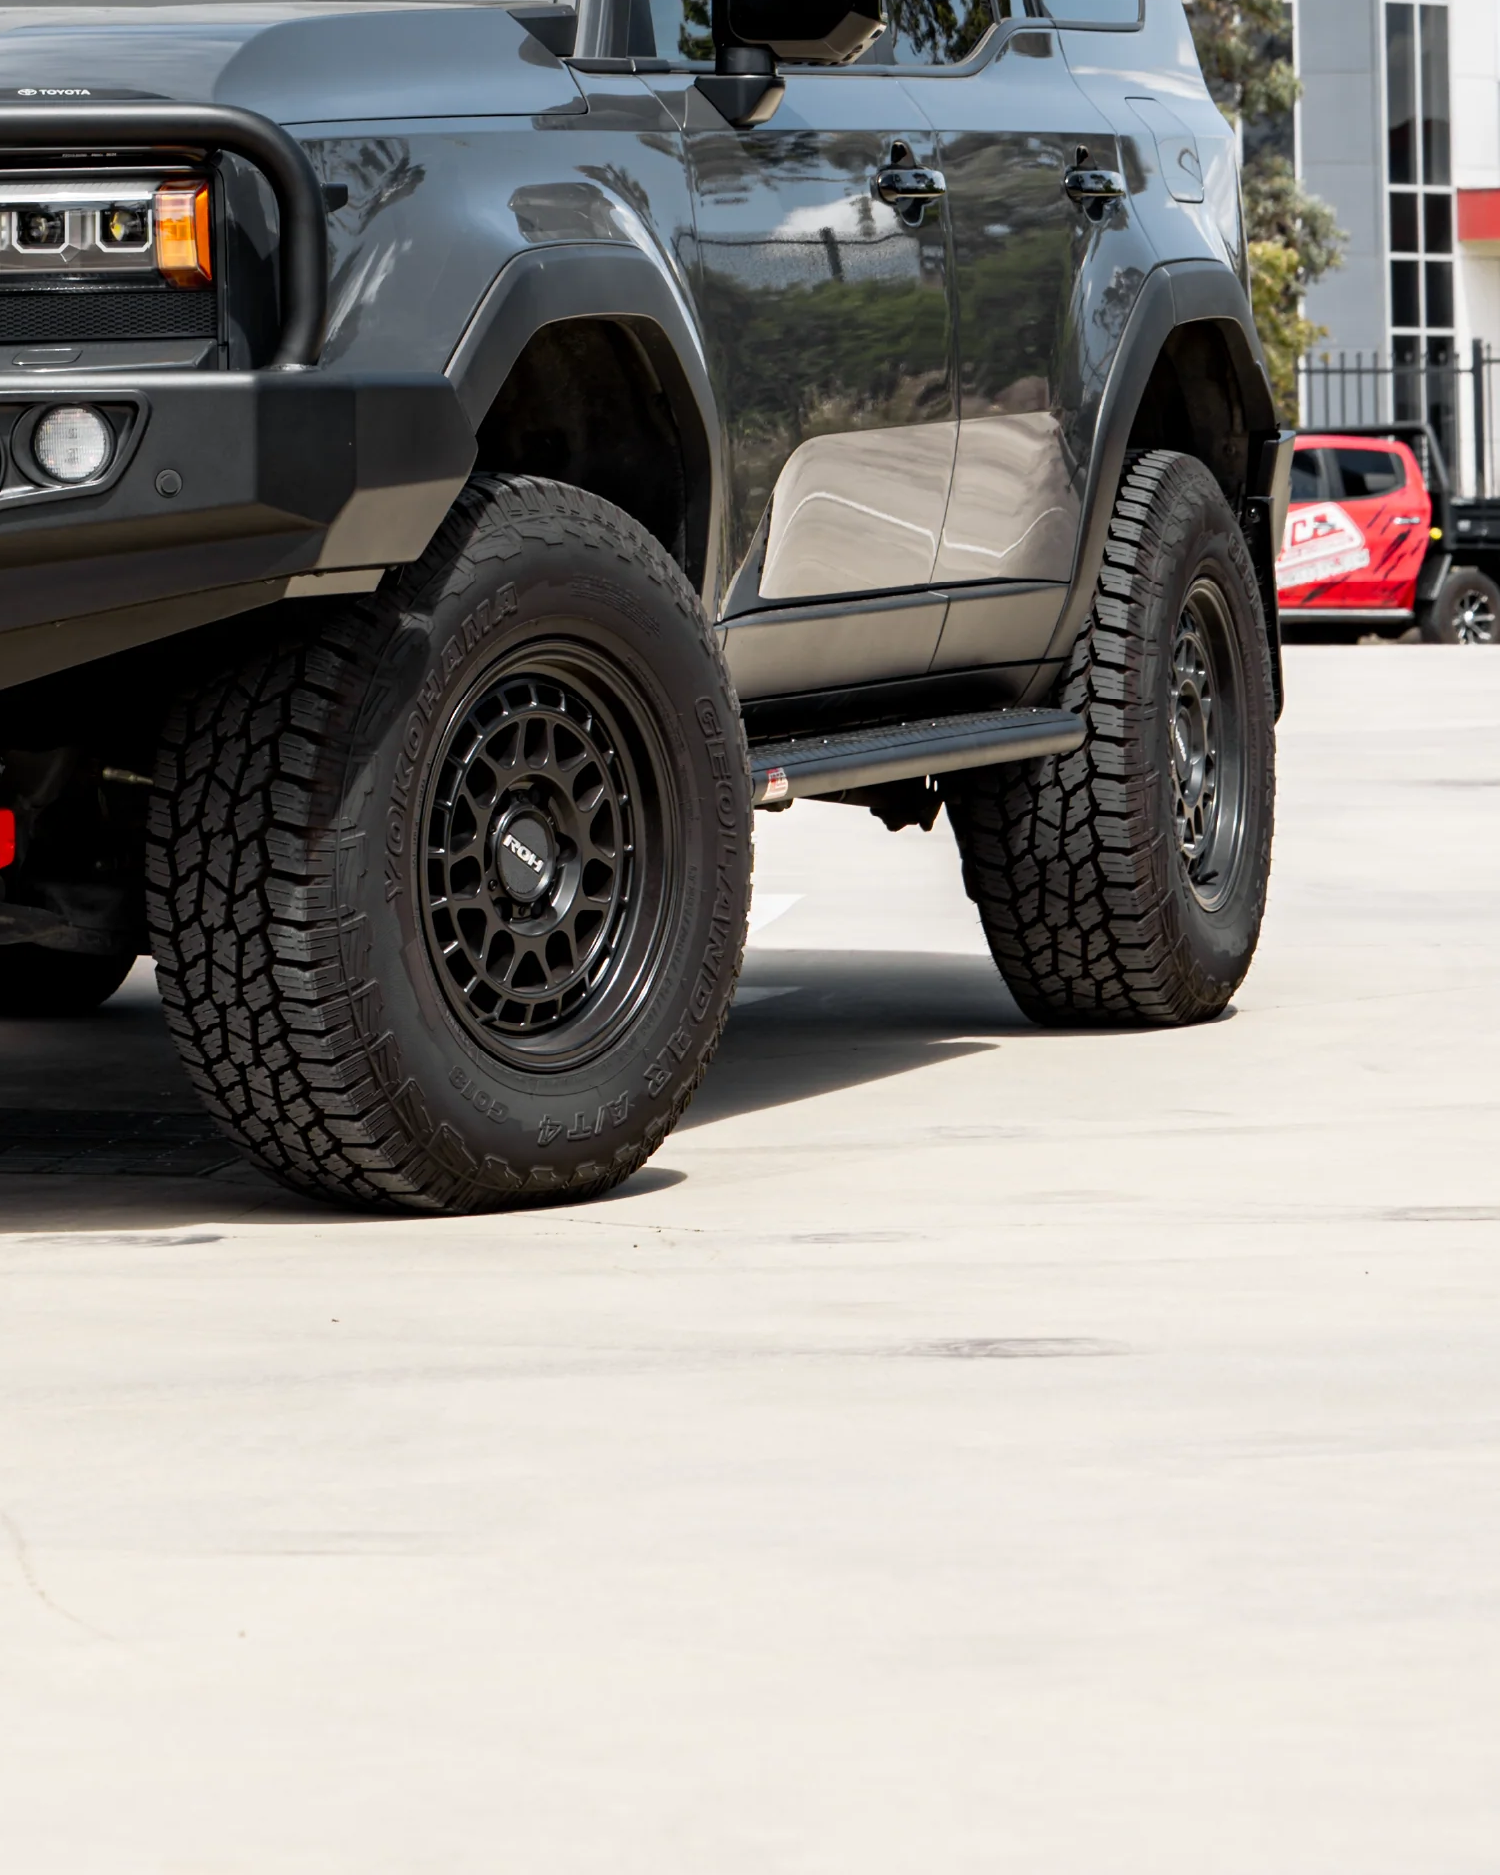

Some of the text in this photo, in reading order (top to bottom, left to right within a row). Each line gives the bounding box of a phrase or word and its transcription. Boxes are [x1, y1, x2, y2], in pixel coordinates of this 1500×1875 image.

[385, 581, 518, 903] YOKOHAMA
[502, 834, 545, 873] ROH
[643, 695, 737, 1099] GEOLANDAR
[537, 1090, 630, 1147] A/T4
